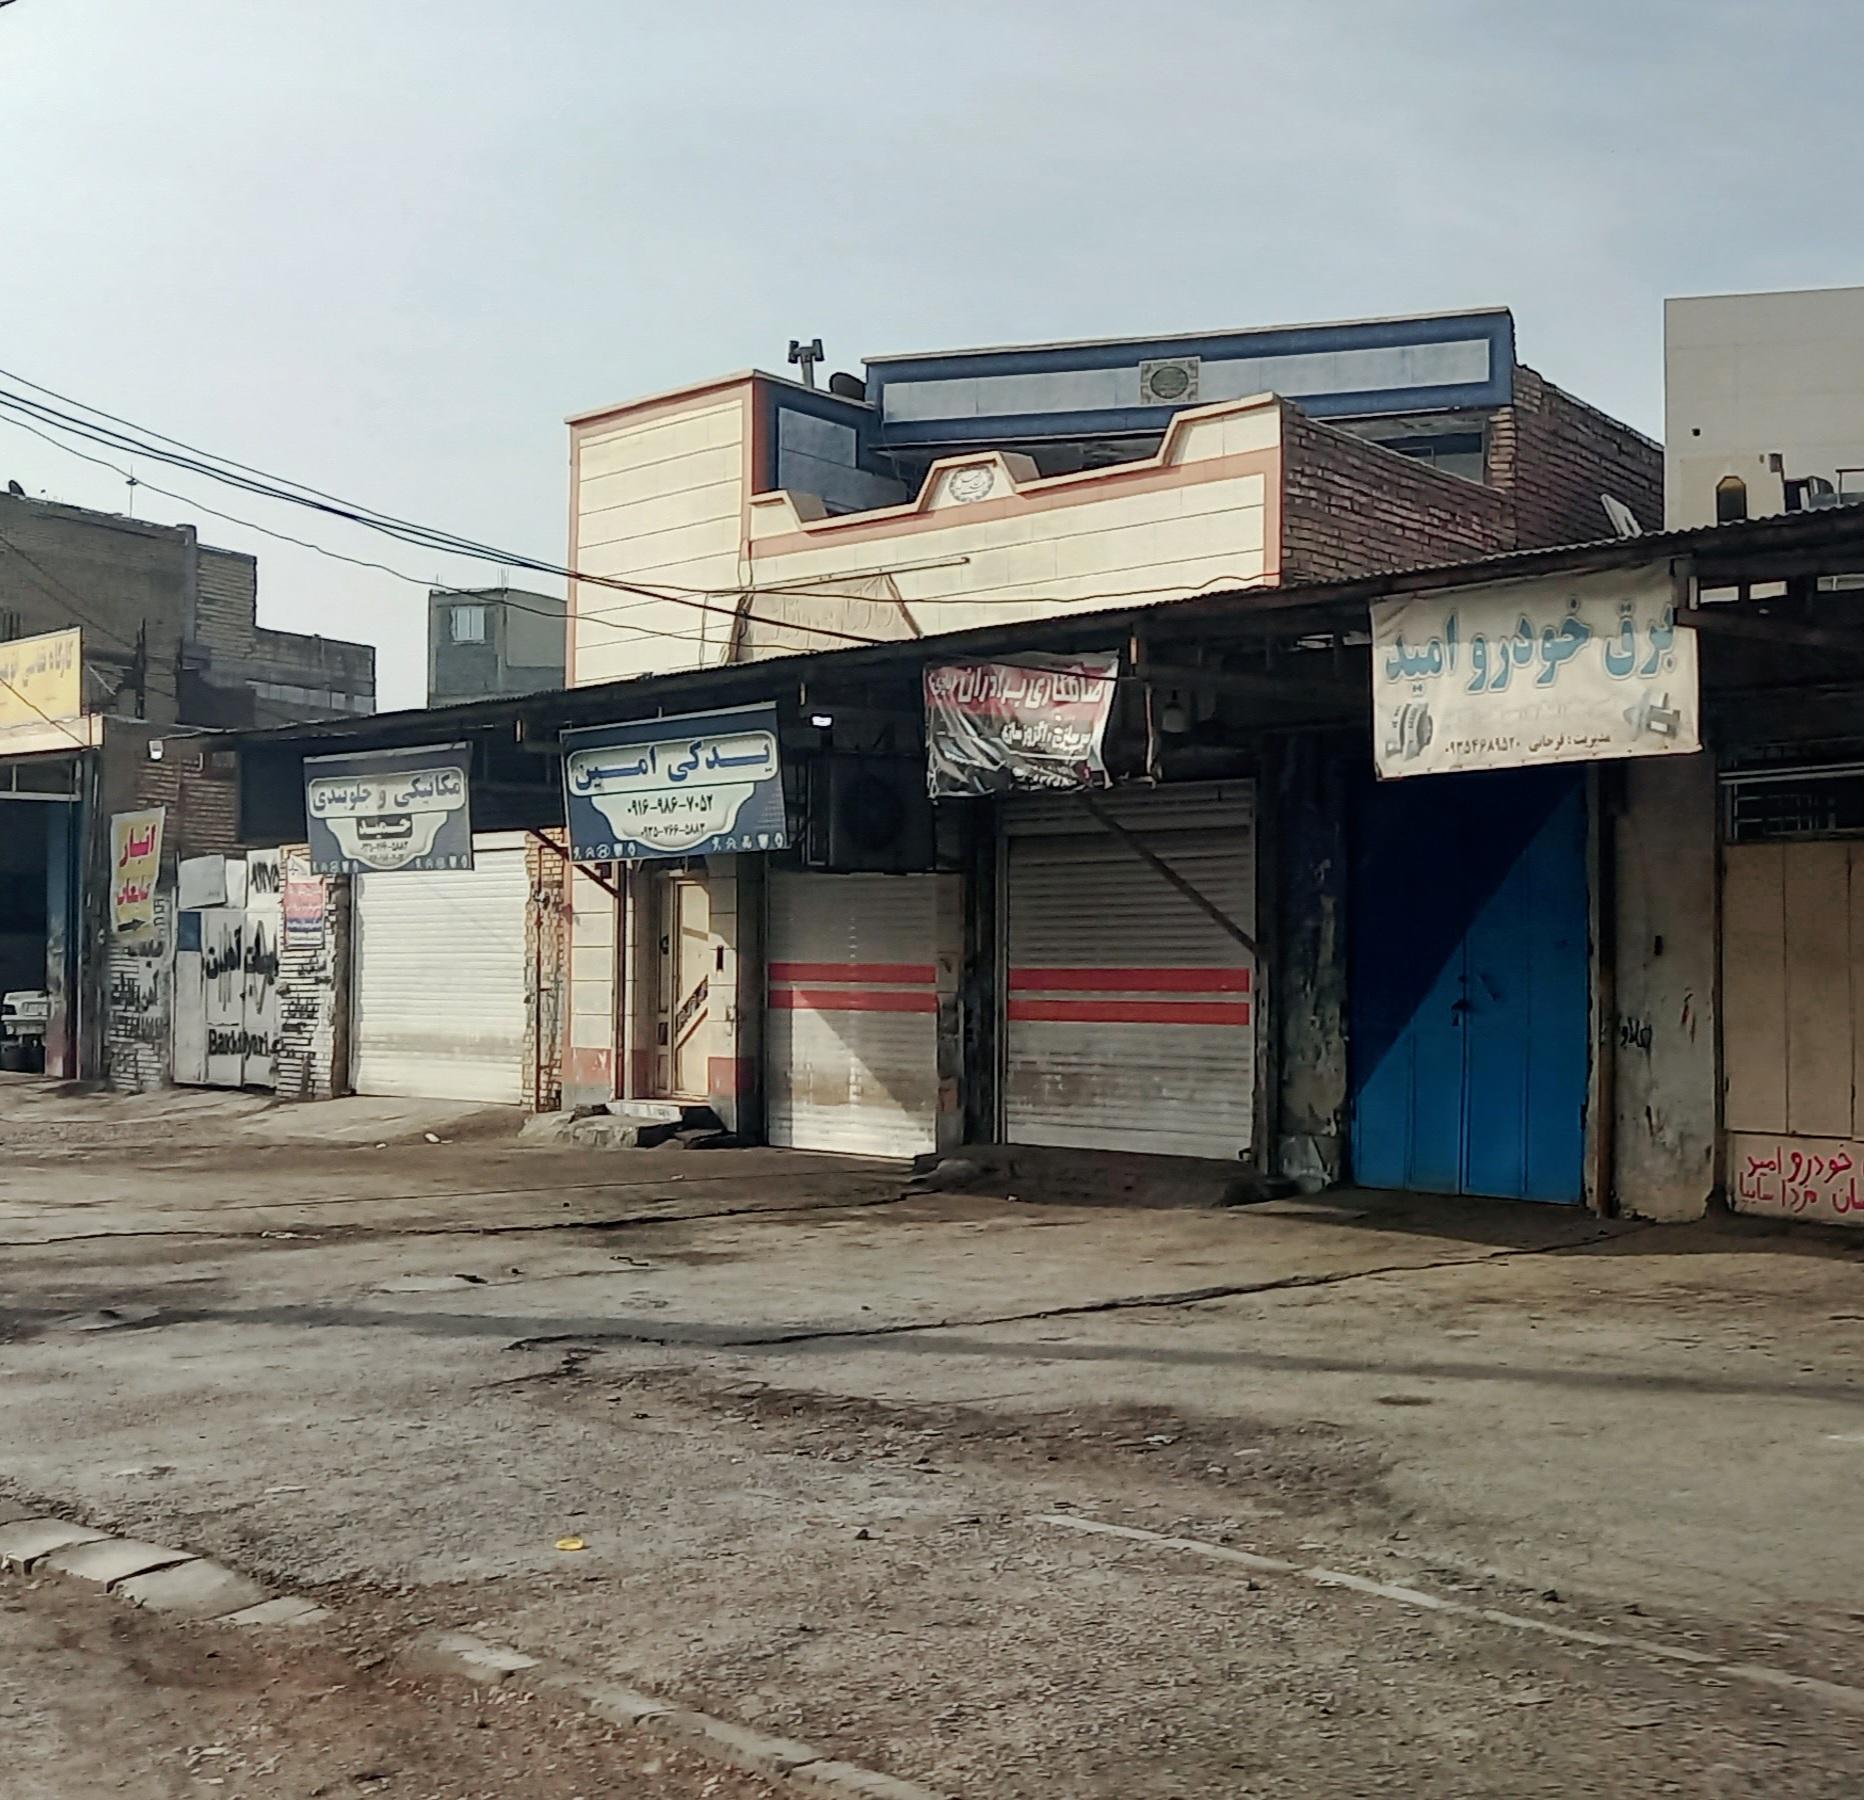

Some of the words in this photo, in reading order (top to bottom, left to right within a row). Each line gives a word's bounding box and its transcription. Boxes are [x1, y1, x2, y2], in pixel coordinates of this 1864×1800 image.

[1384, 608, 1459, 696] امید
[1466, 595, 1592, 694] خودرو
[1603, 599, 1677, 681] برق
[959, 666, 1026, 707] برادران
[1025, 675, 1105, 709] صافکاری
[575, 746, 657, 791] امین
[668, 741, 773, 782] یدکی
[313, 783, 372, 812] جلوبندی
[377, 789, 386, 808] و
[394, 774, 460, 806] مکانیکی
[119, 824, 156, 867] انبار
[358, 818, 411, 839] حمید
[1787, 1144, 1853, 1186] خودرو
[1781, 1179, 1817, 1213] مزدا
